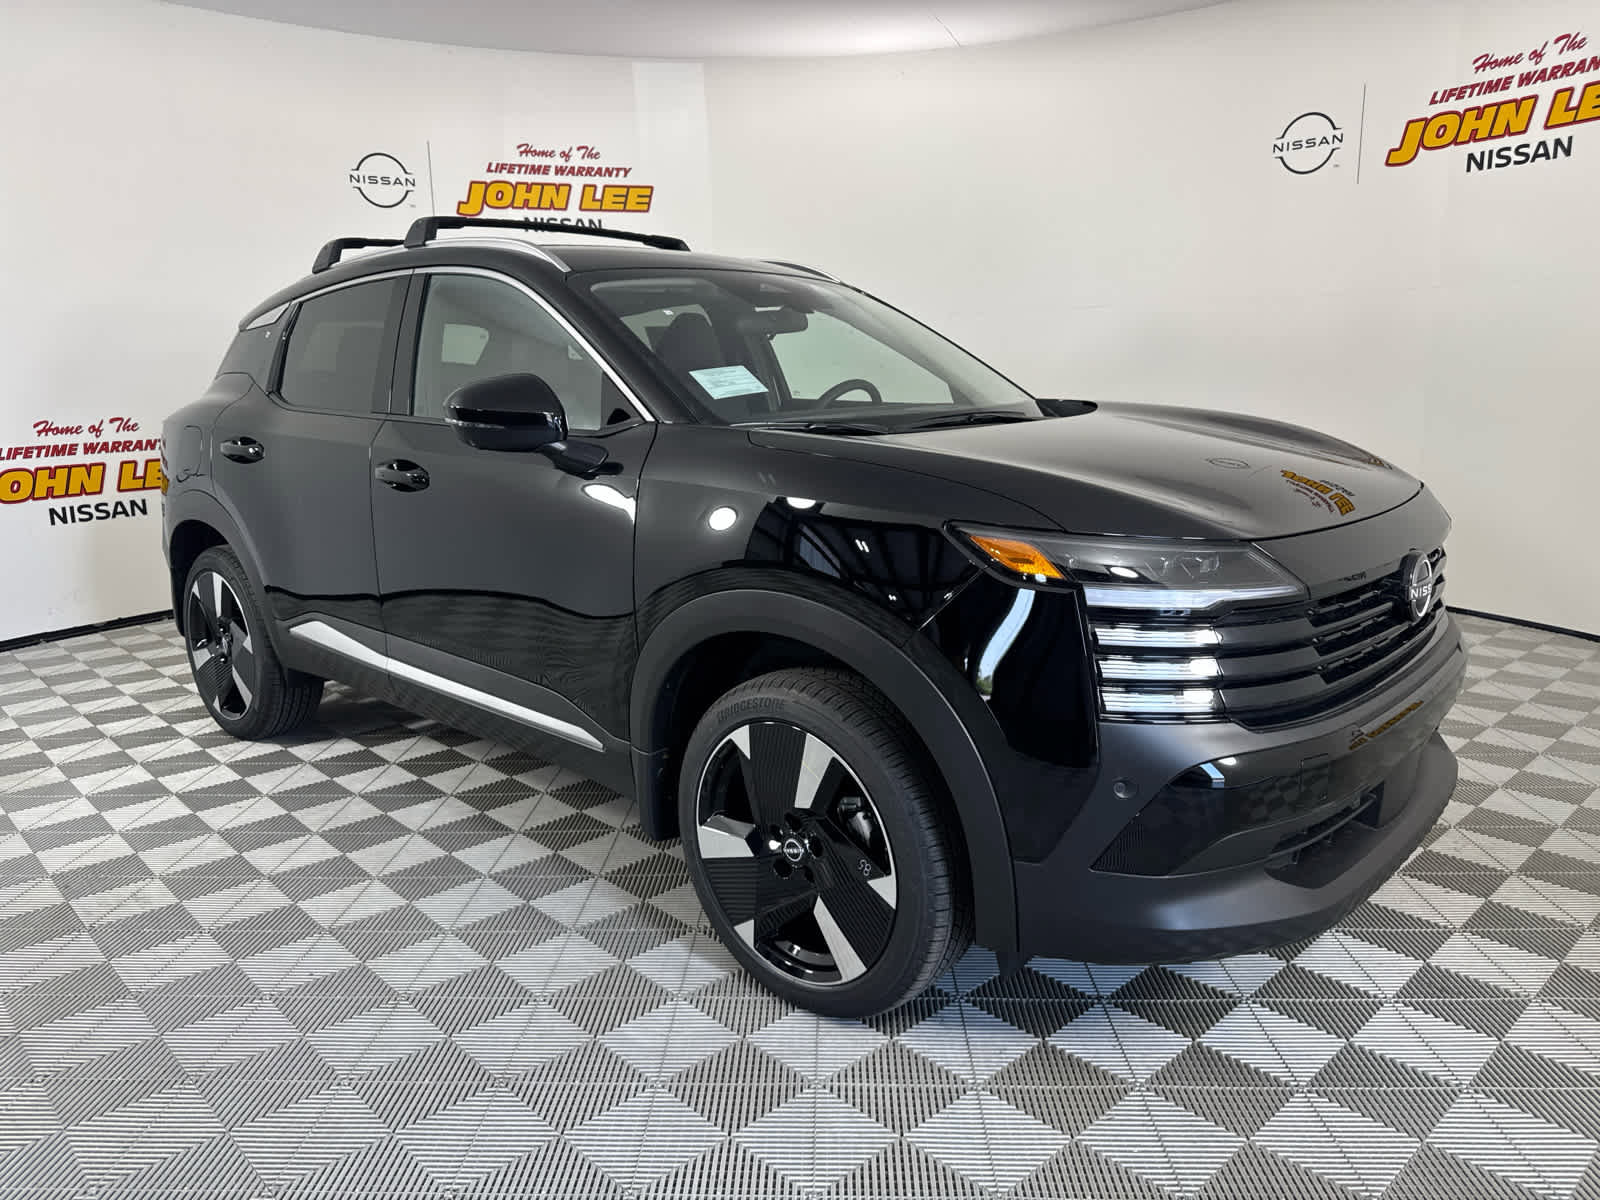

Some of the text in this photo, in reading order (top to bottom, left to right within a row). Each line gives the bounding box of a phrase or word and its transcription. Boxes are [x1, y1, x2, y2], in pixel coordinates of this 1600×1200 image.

[1471, 31, 1587, 75] Home of The
[1428, 56, 1600, 106] LIFETIME WARRAN
[1384, 80, 1600, 167] JOHN LE
[516, 142, 601, 161] Home of The
[1272, 132, 1344, 154] NISSAN
[1465, 135, 1574, 173] NISSAN
[348, 173, 417, 188] NISSAN
[486, 162, 632, 178] LIFETIME WARRANTY
[456, 180, 655, 217] JOHN LEE
[32, 417, 140, 438] Home of The
[0, 438, 161, 461] LIFETIME WARRAN
[0, 458, 162, 504] OHN LE
[49, 498, 148, 526] NISSAN
[1410, 583, 1432, 599] NISS
